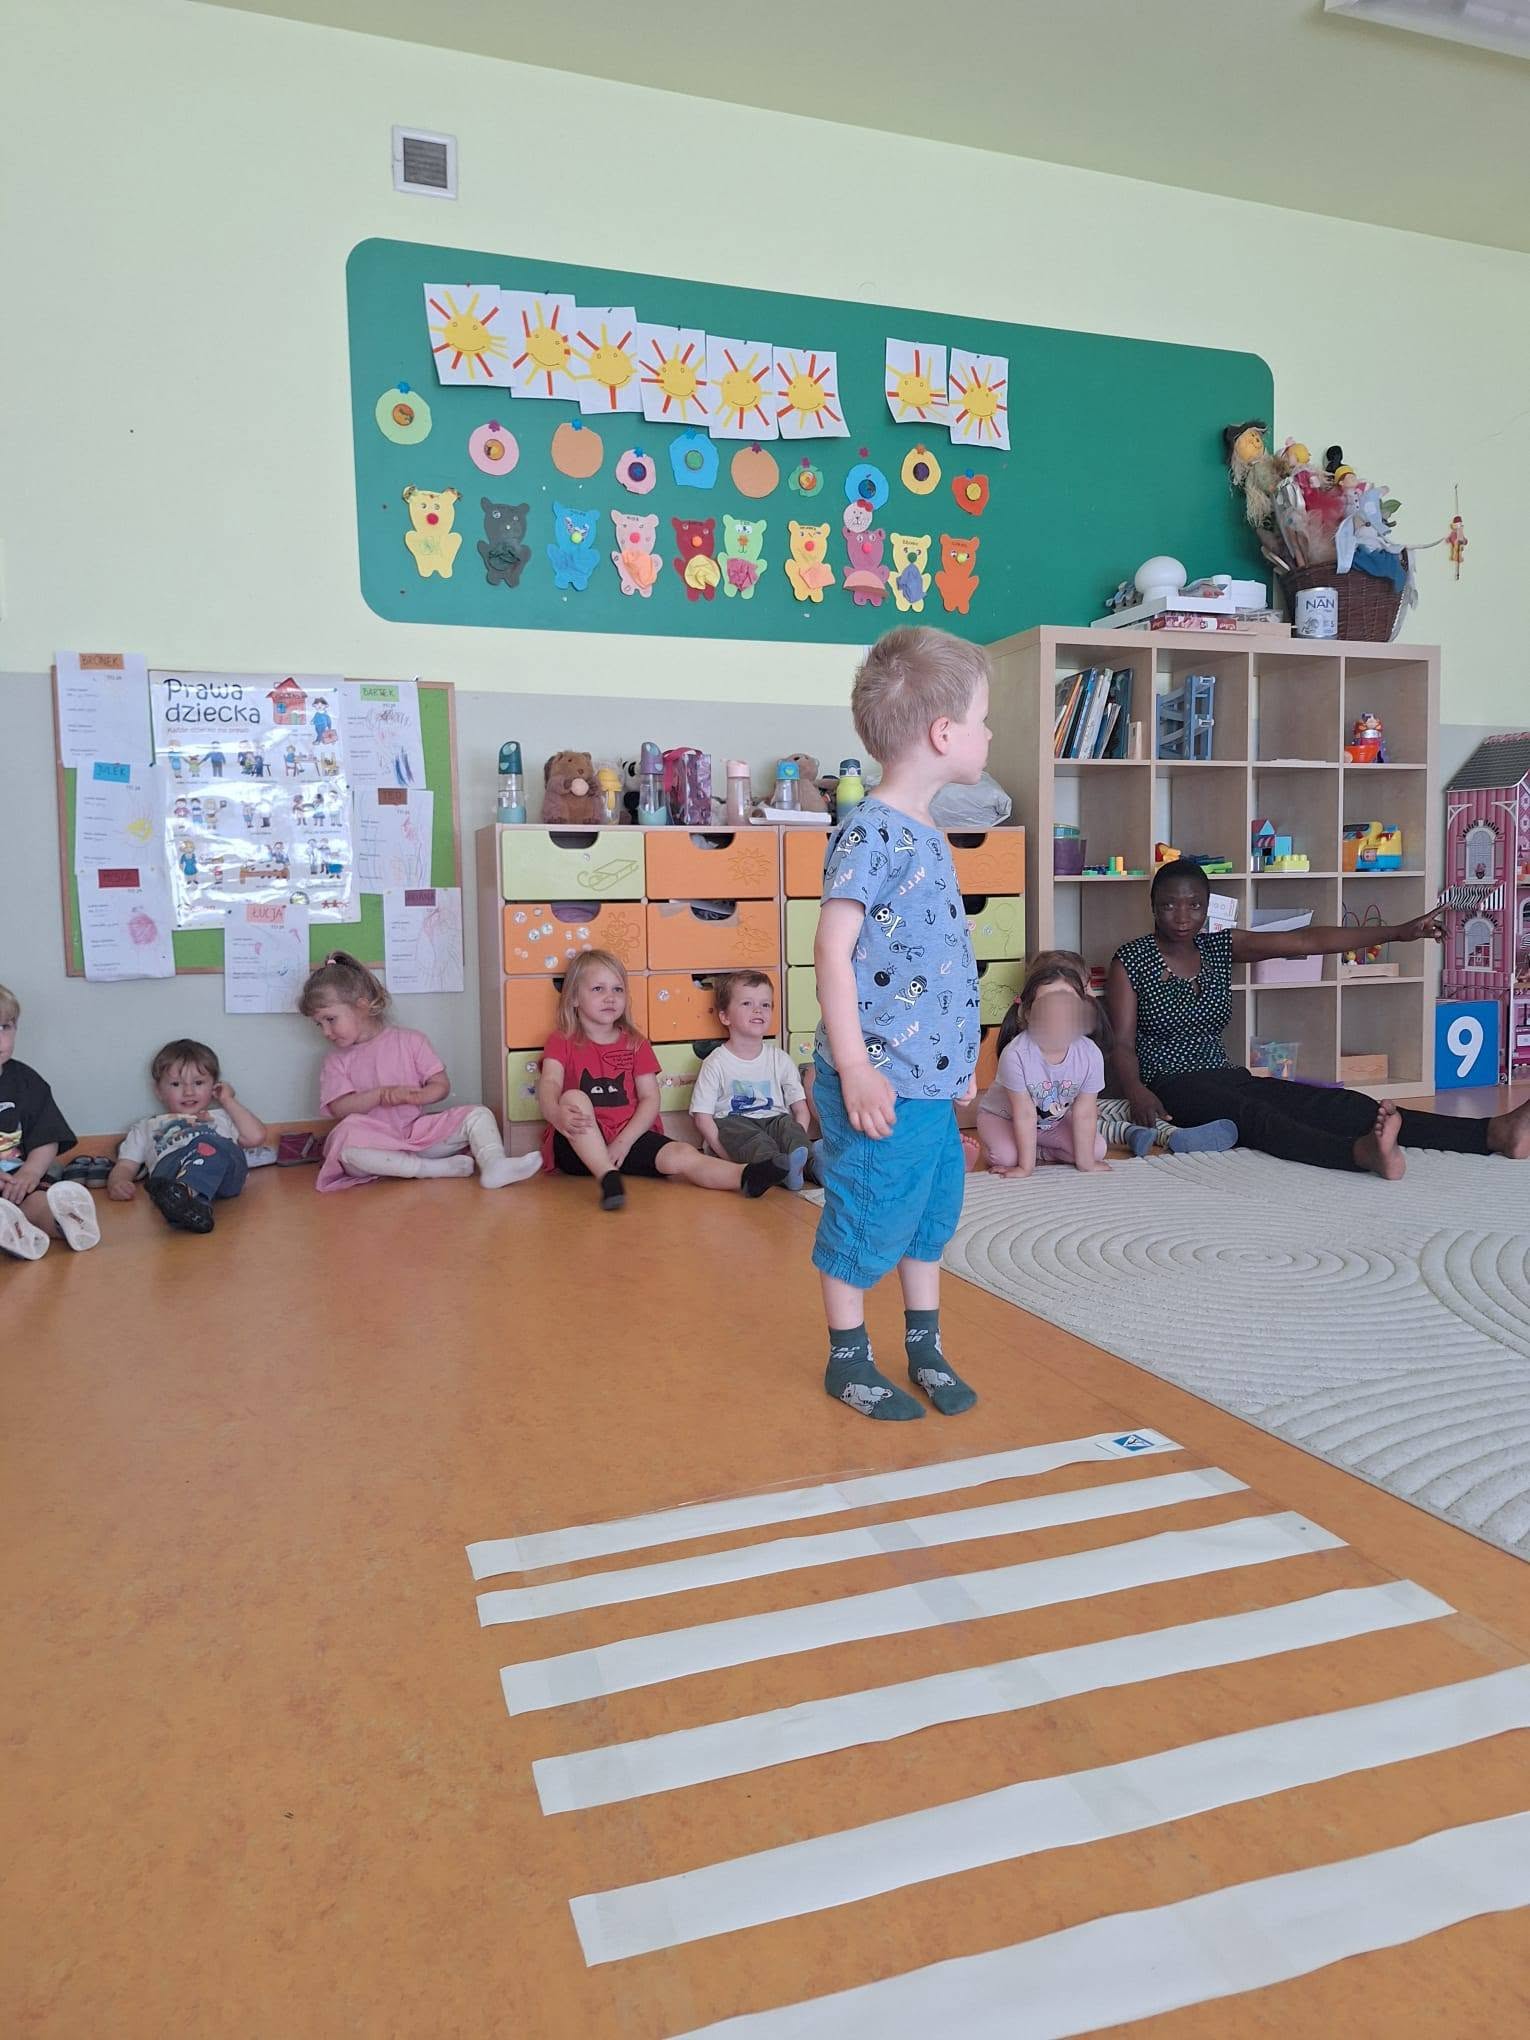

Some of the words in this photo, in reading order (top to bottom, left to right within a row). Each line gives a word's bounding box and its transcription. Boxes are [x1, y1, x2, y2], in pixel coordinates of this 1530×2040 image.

[1306, 599, 1334, 610] NAN
[163, 678, 243, 701] Prawa
[165, 702, 261, 724] dziecka
[1447, 1015, 1484, 1078] 9
